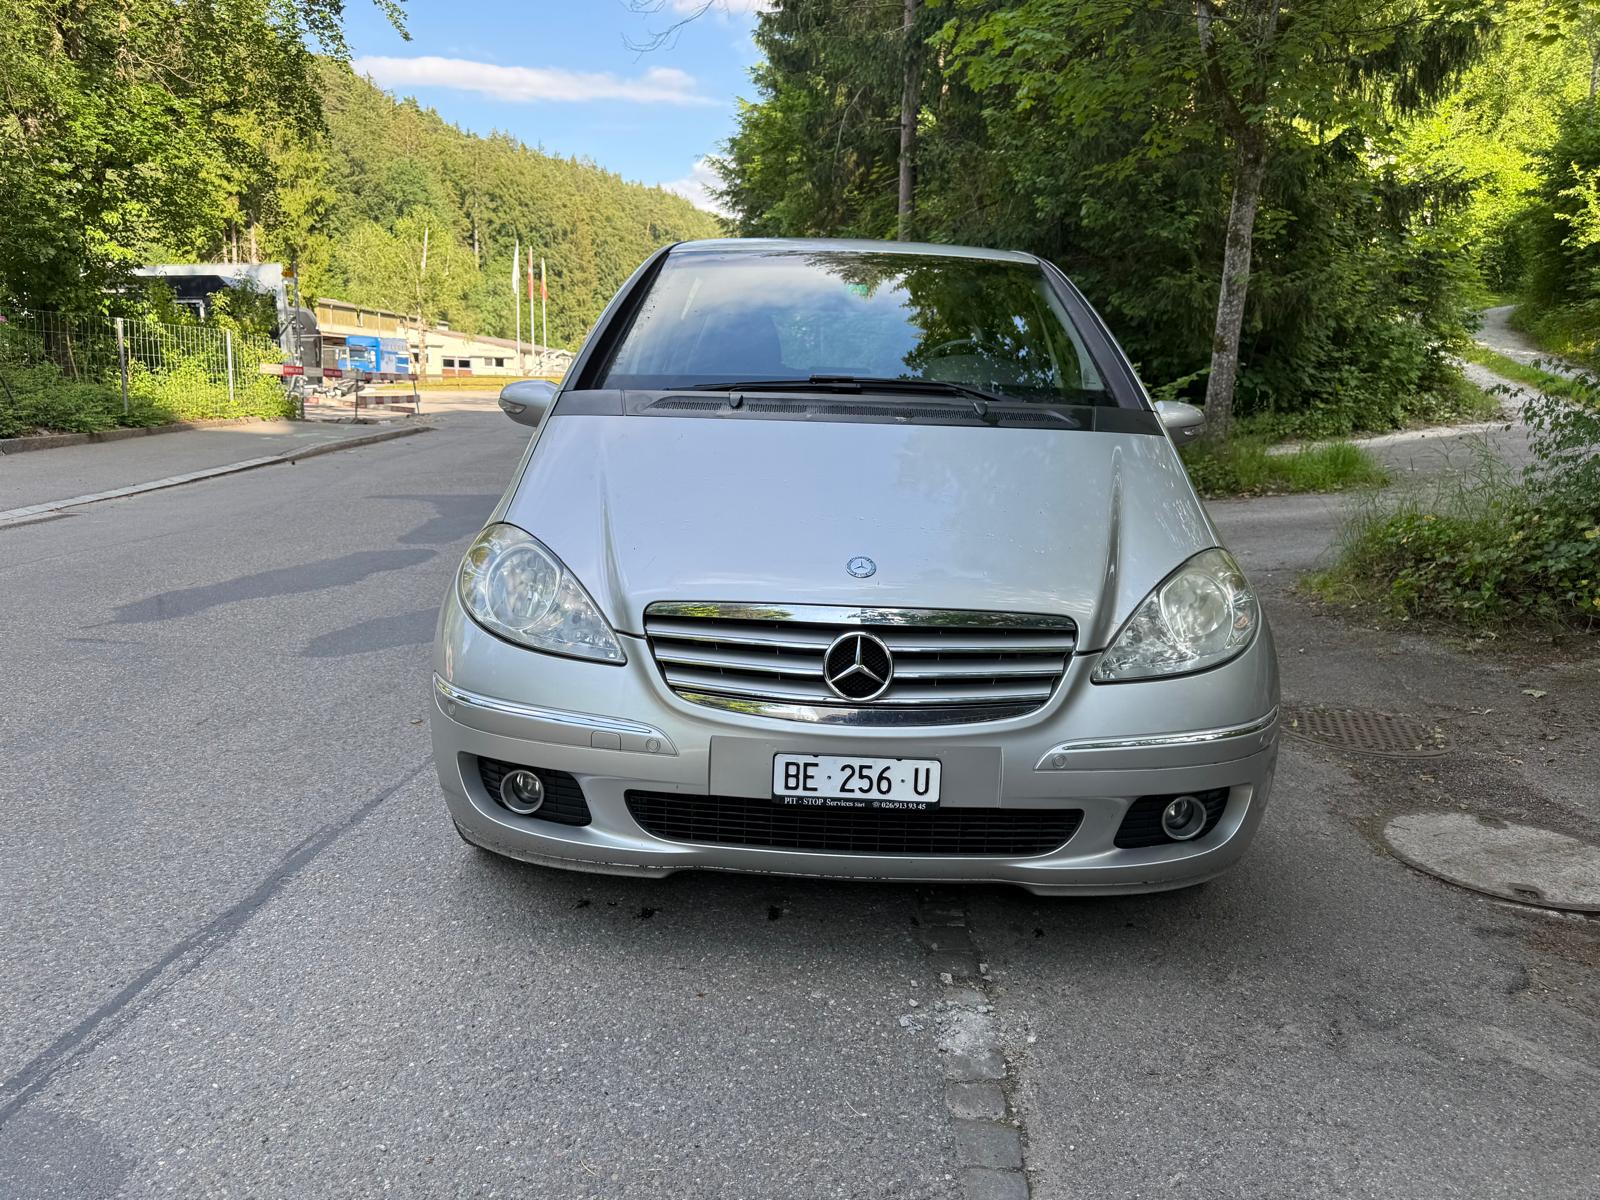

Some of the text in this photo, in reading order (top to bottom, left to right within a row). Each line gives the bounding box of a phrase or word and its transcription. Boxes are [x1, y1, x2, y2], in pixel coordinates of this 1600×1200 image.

[784, 761, 931, 796] BE 256 U
[784, 796, 798, 805] PIT
[802, 797, 824, 806] STOP
[825, 798, 854, 808] Services
